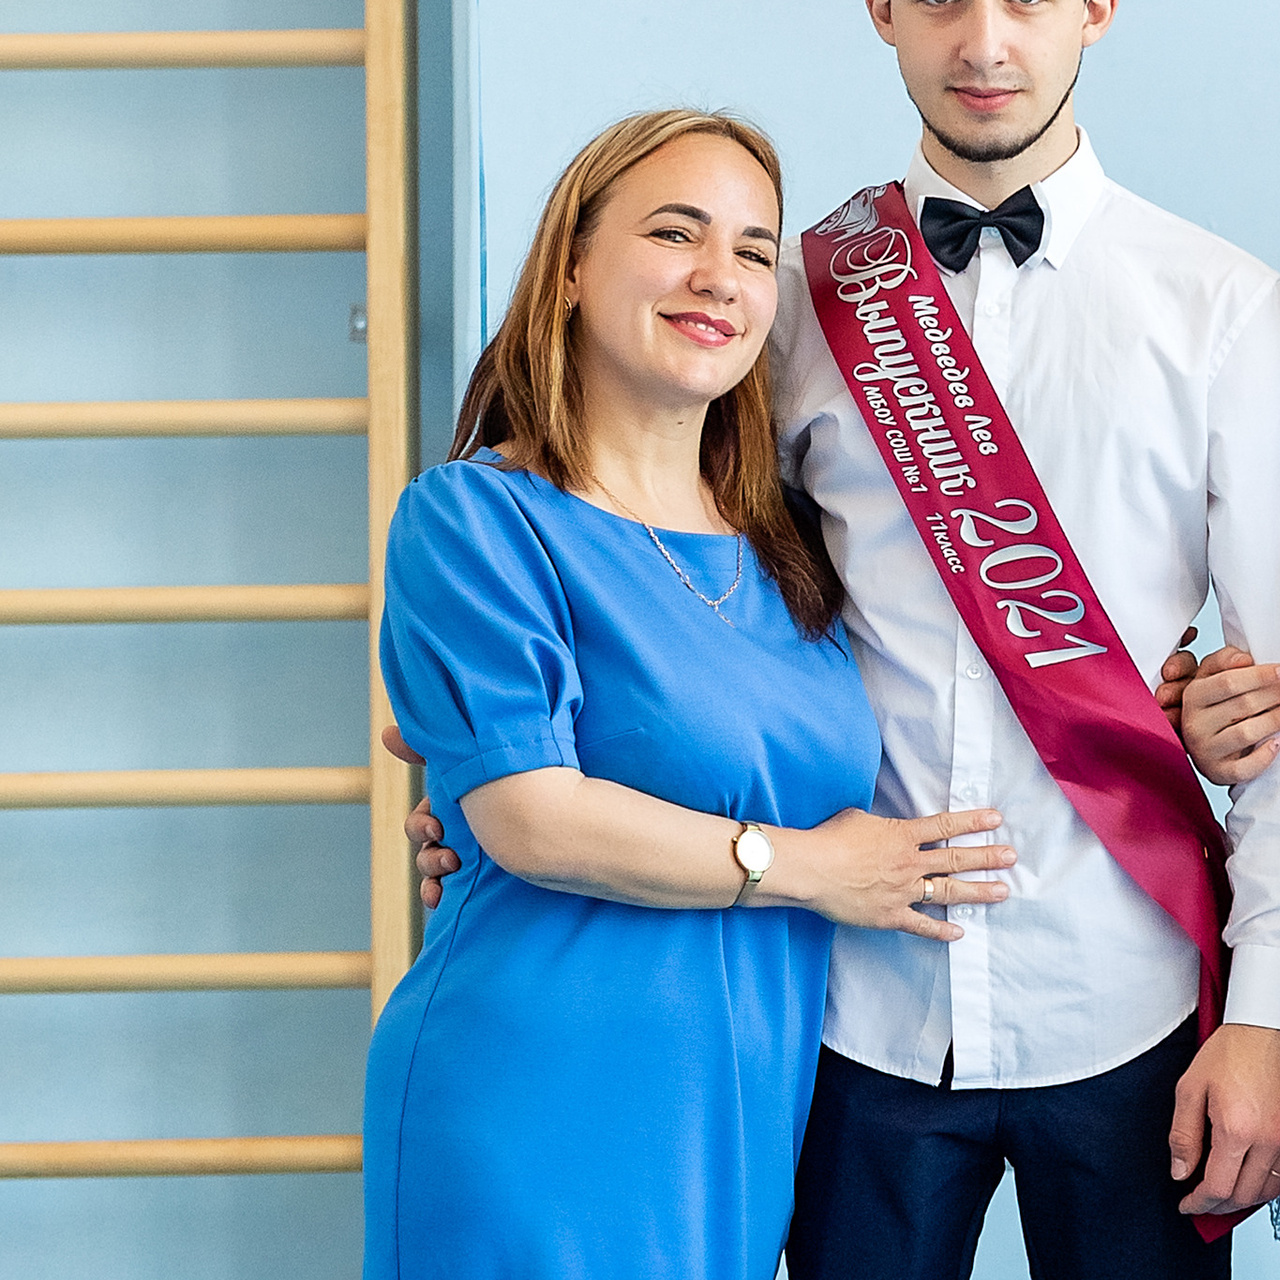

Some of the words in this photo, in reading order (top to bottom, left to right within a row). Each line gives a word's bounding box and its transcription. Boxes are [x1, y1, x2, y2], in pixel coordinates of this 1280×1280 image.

[829, 226, 977, 496] Выпускник
[950, 498, 1108, 669] 2021
[862, 386, 897, 426] МБОУ
[886, 429, 914, 463] СОШ
[908, 294, 974, 409] Медведев
[965, 415, 998, 455] Лев
